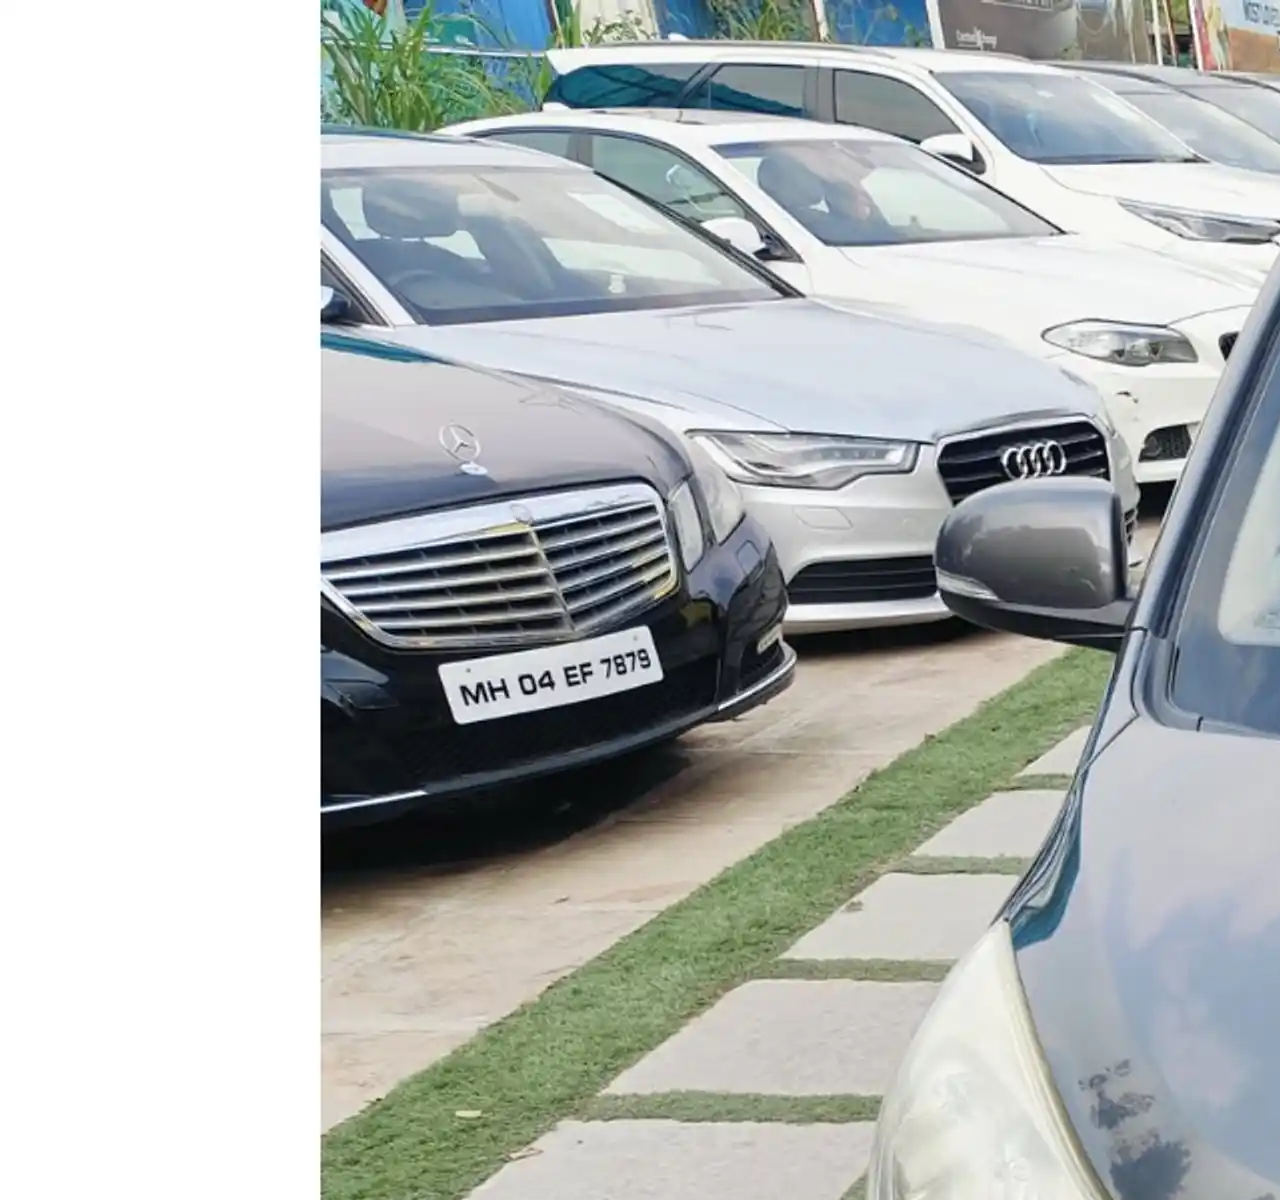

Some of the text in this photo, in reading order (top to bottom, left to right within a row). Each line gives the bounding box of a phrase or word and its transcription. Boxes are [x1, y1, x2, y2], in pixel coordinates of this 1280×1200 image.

[459, 648, 652, 707] MH 04 EF 7879
